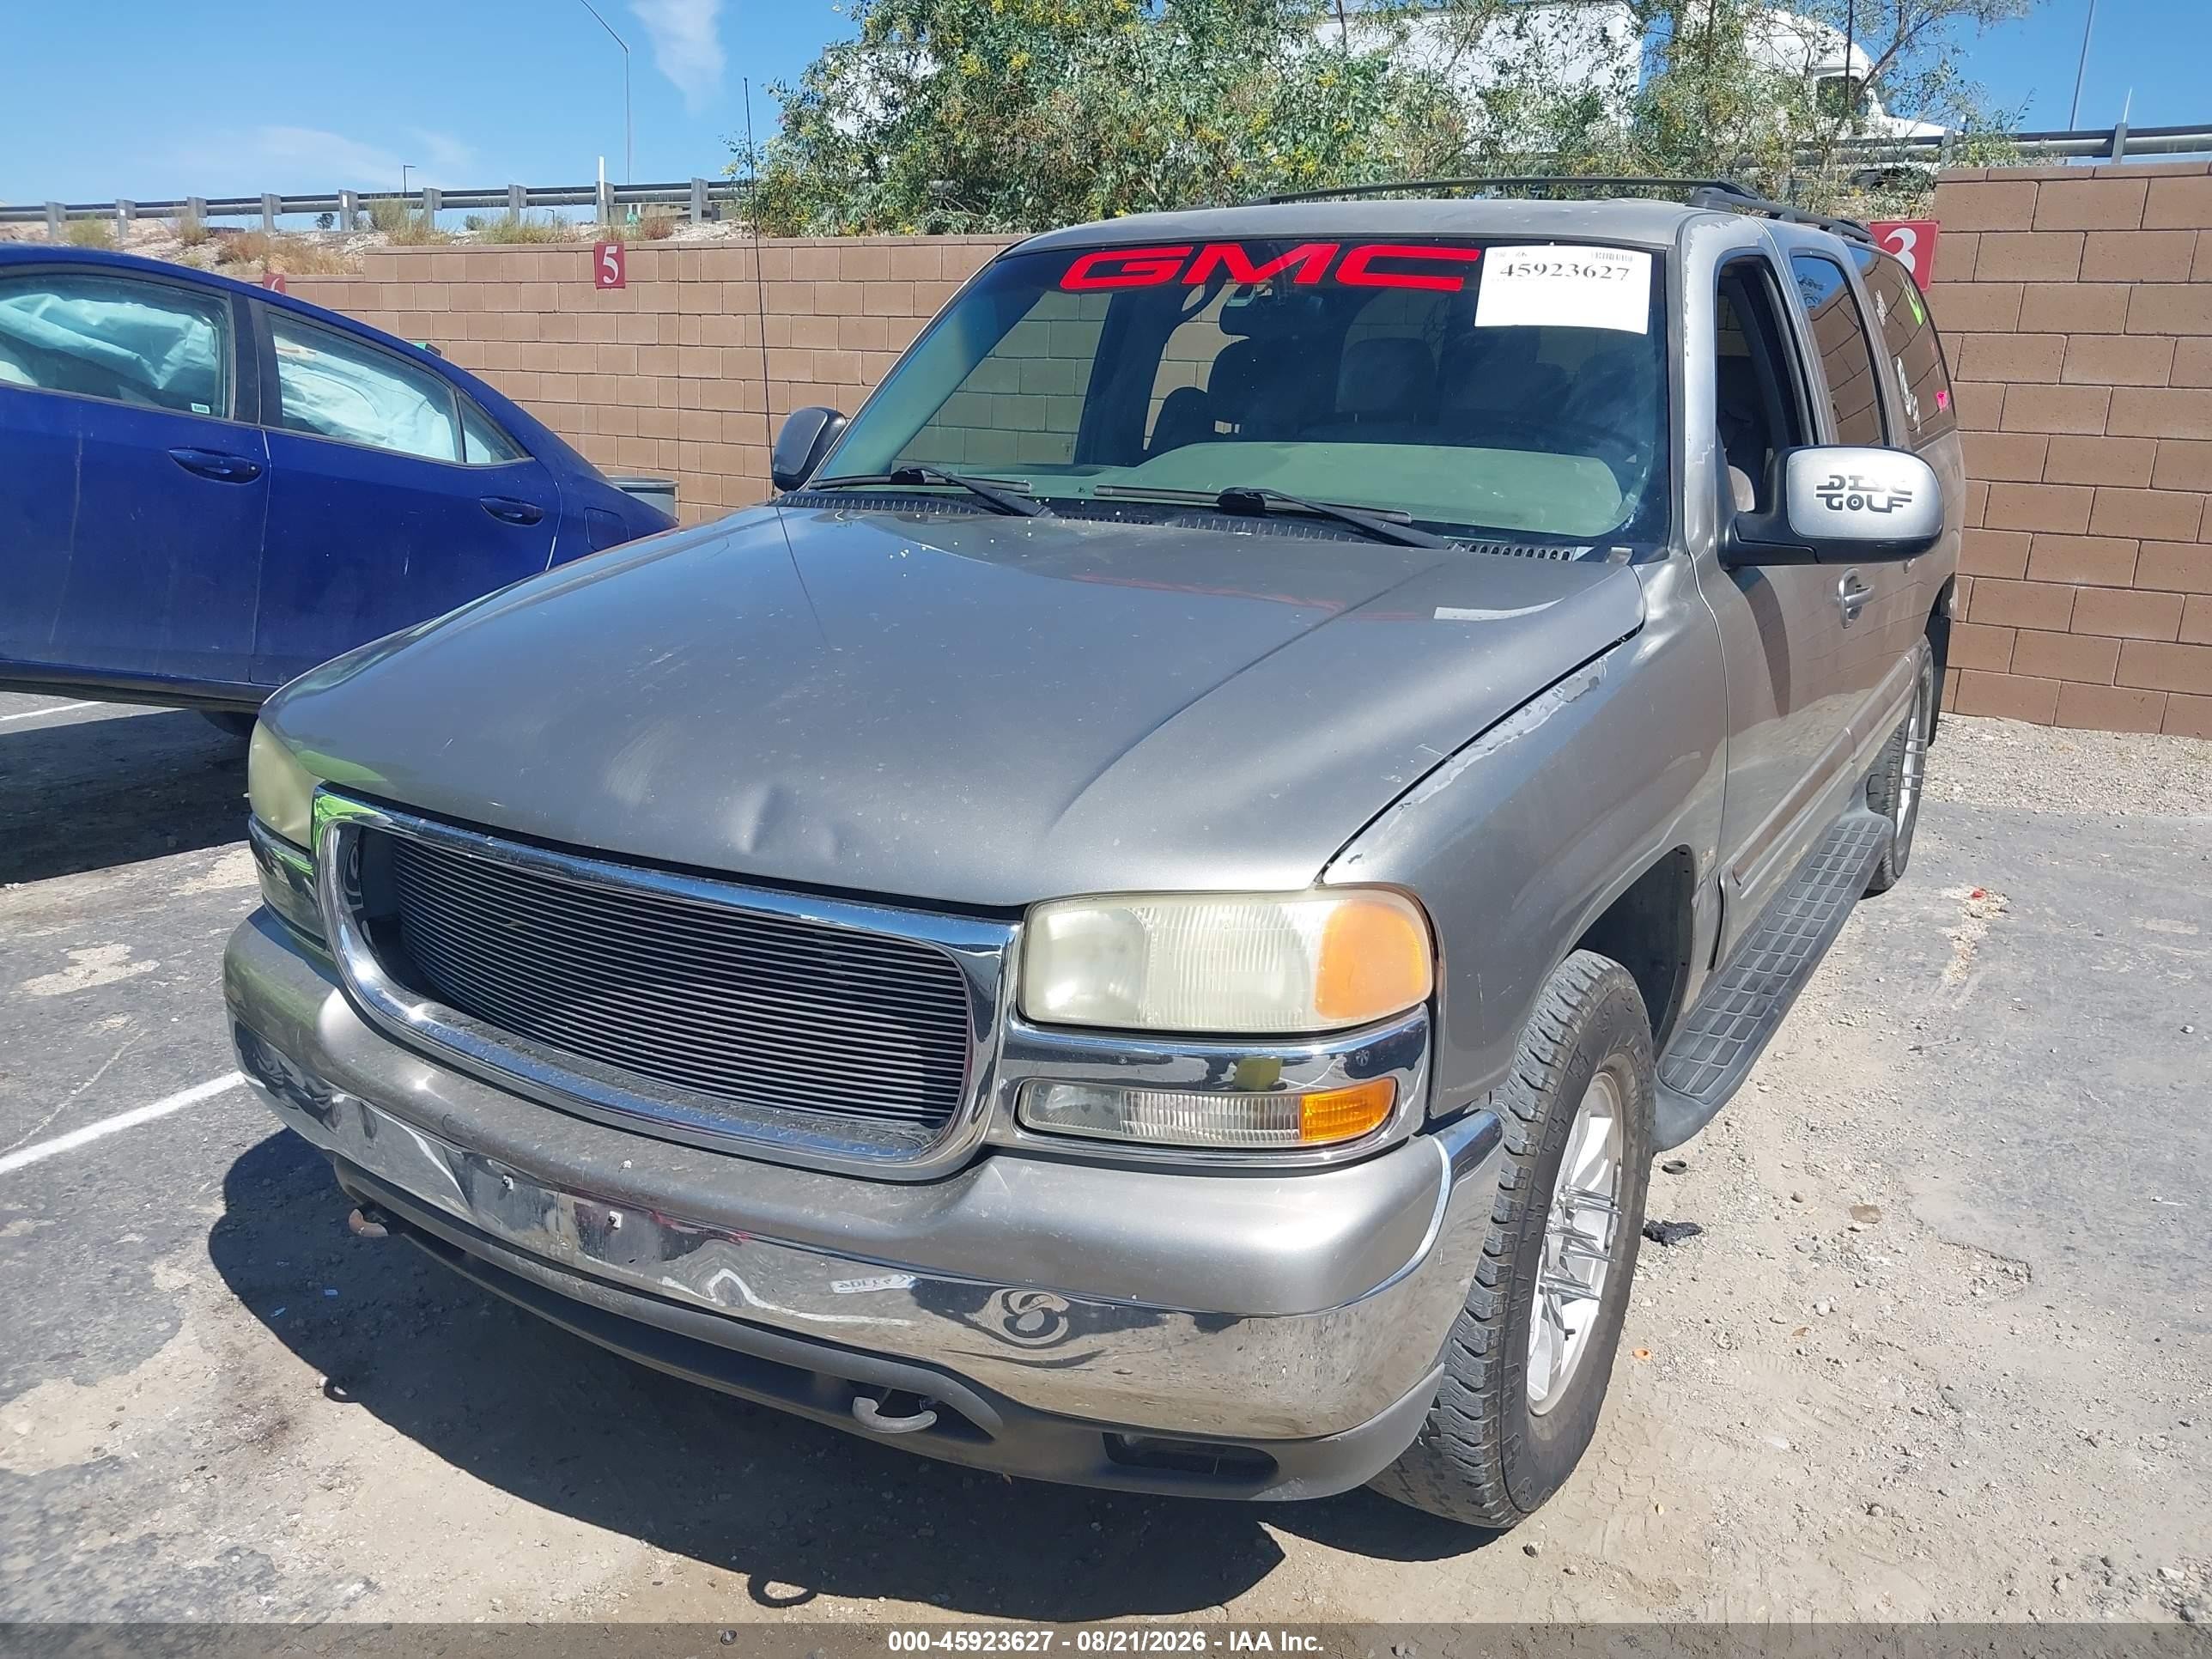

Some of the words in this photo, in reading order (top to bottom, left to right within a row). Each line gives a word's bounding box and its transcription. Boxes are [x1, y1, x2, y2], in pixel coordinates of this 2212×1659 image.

[603, 246, 618, 283] 5
[1060, 244, 1480, 291] GMC
[1884, 228, 1917, 274] 3
[1499, 263, 1631, 282] 45923627
[1816, 493, 1912, 514] GOLF
